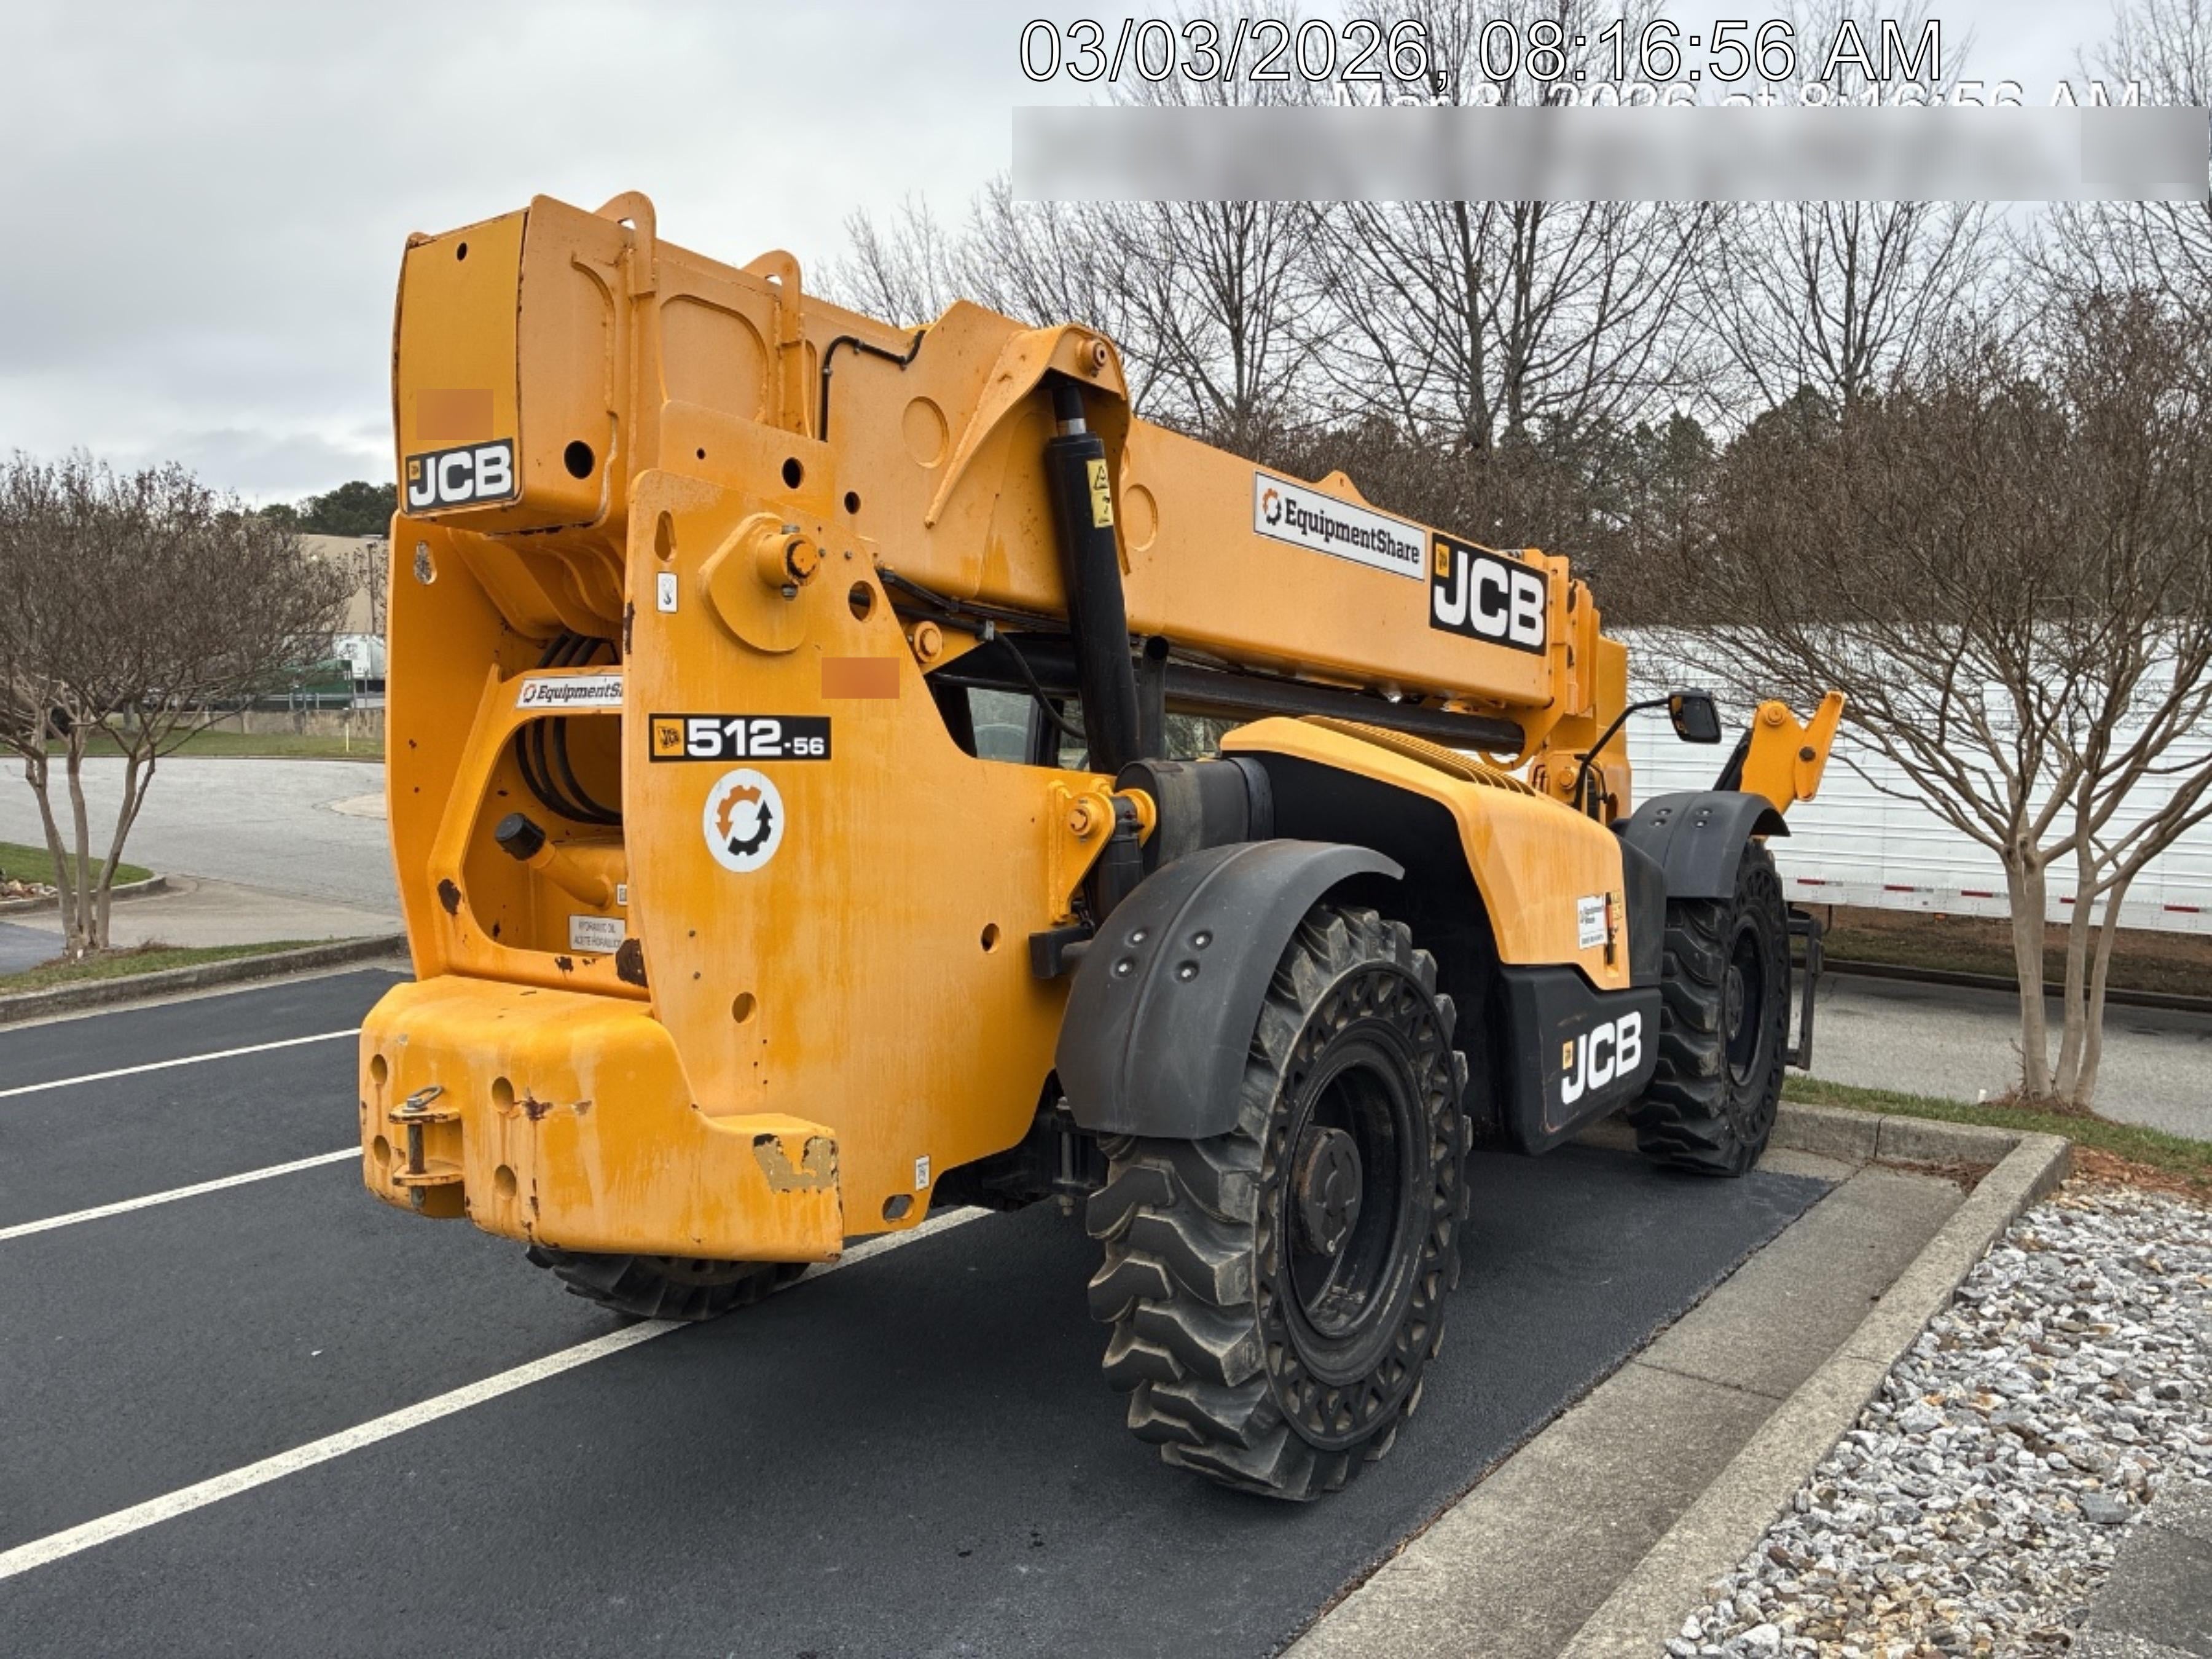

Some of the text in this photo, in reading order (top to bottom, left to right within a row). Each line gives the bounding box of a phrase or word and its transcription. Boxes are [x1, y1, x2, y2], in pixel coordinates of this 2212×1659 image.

[409, 445, 512, 506] JCB
[1284, 498, 1421, 565] EquipmentShare
[1433, 551, 1545, 647] JCB
[537, 681, 623, 703] EquipmentS
[686, 718, 825, 757] 512-56
[1561, 1011, 1642, 1105] JCB
